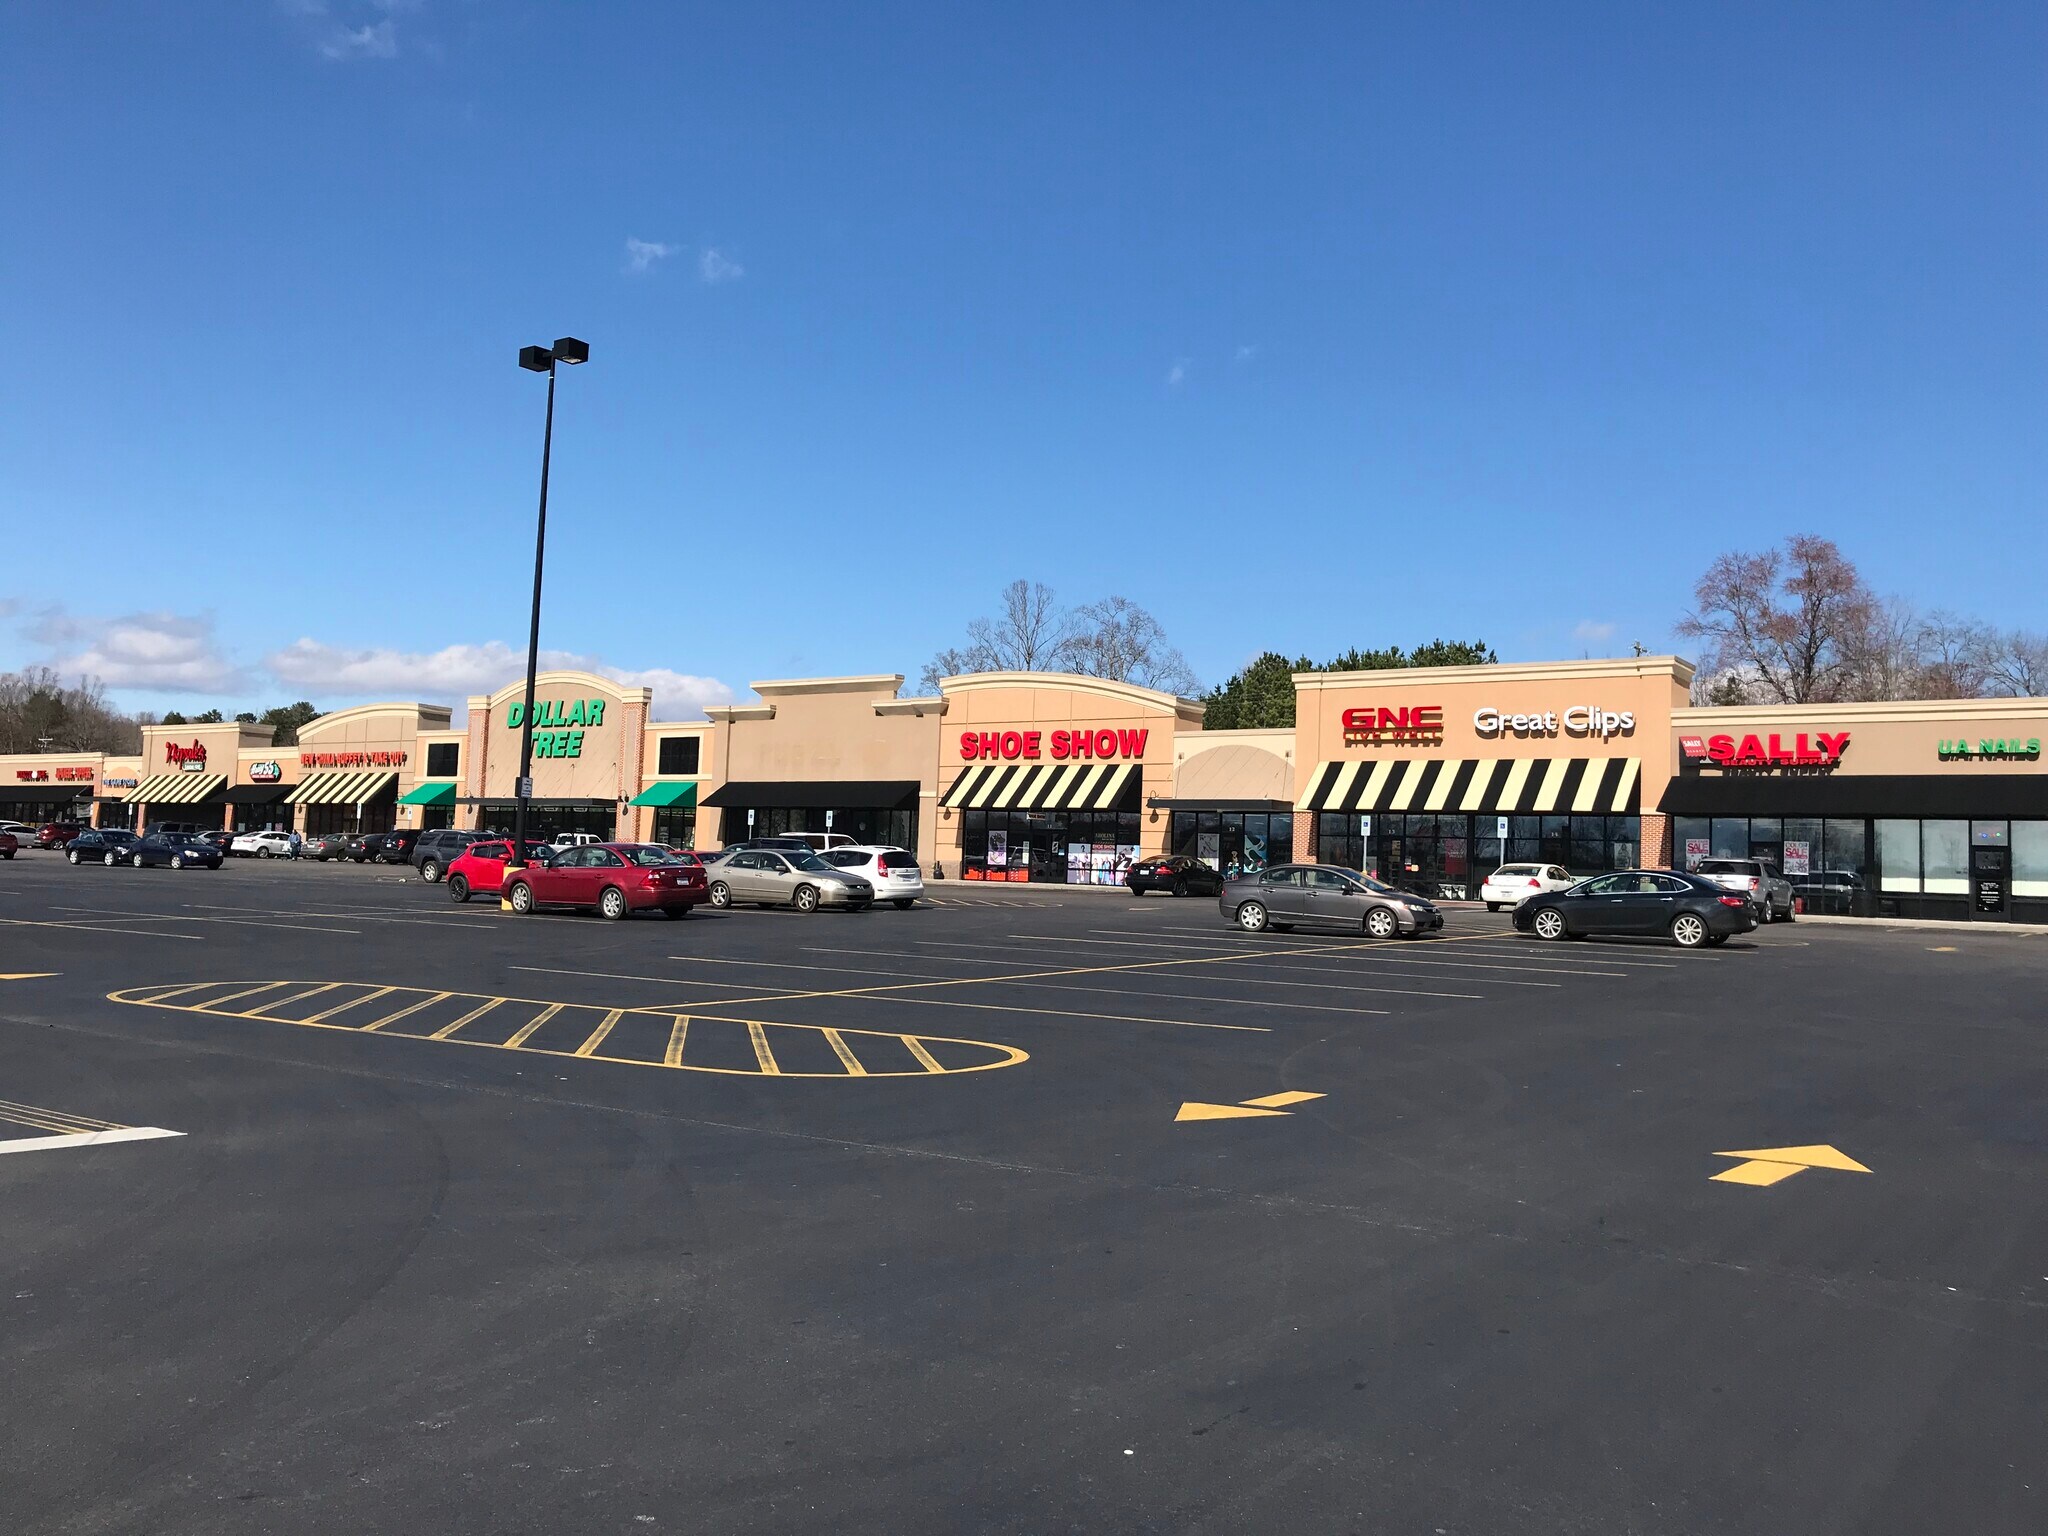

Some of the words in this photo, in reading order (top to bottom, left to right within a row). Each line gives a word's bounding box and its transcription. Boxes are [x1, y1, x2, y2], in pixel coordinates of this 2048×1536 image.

[1342, 706, 1442, 728] GNC
[1473, 707, 1558, 731] Great
[1563, 705, 1635, 736] Clips
[1343, 731, 1381, 740] LIVE
[1392, 730, 1441, 740] WELL
[959, 731, 1041, 759] SHOE
[1050, 729, 1149, 759] SHOW
[1682, 739, 1702, 748] SALLY
[1708, 732, 1851, 760] SALLY
[1979, 738, 2041, 754] NAILS
[1721, 758, 1774, 766] BEAUTY
[1780, 758, 1834, 766] SUPPLY
[1687, 842, 1708, 852] SALE
[1785, 848, 1807, 857] SALE
